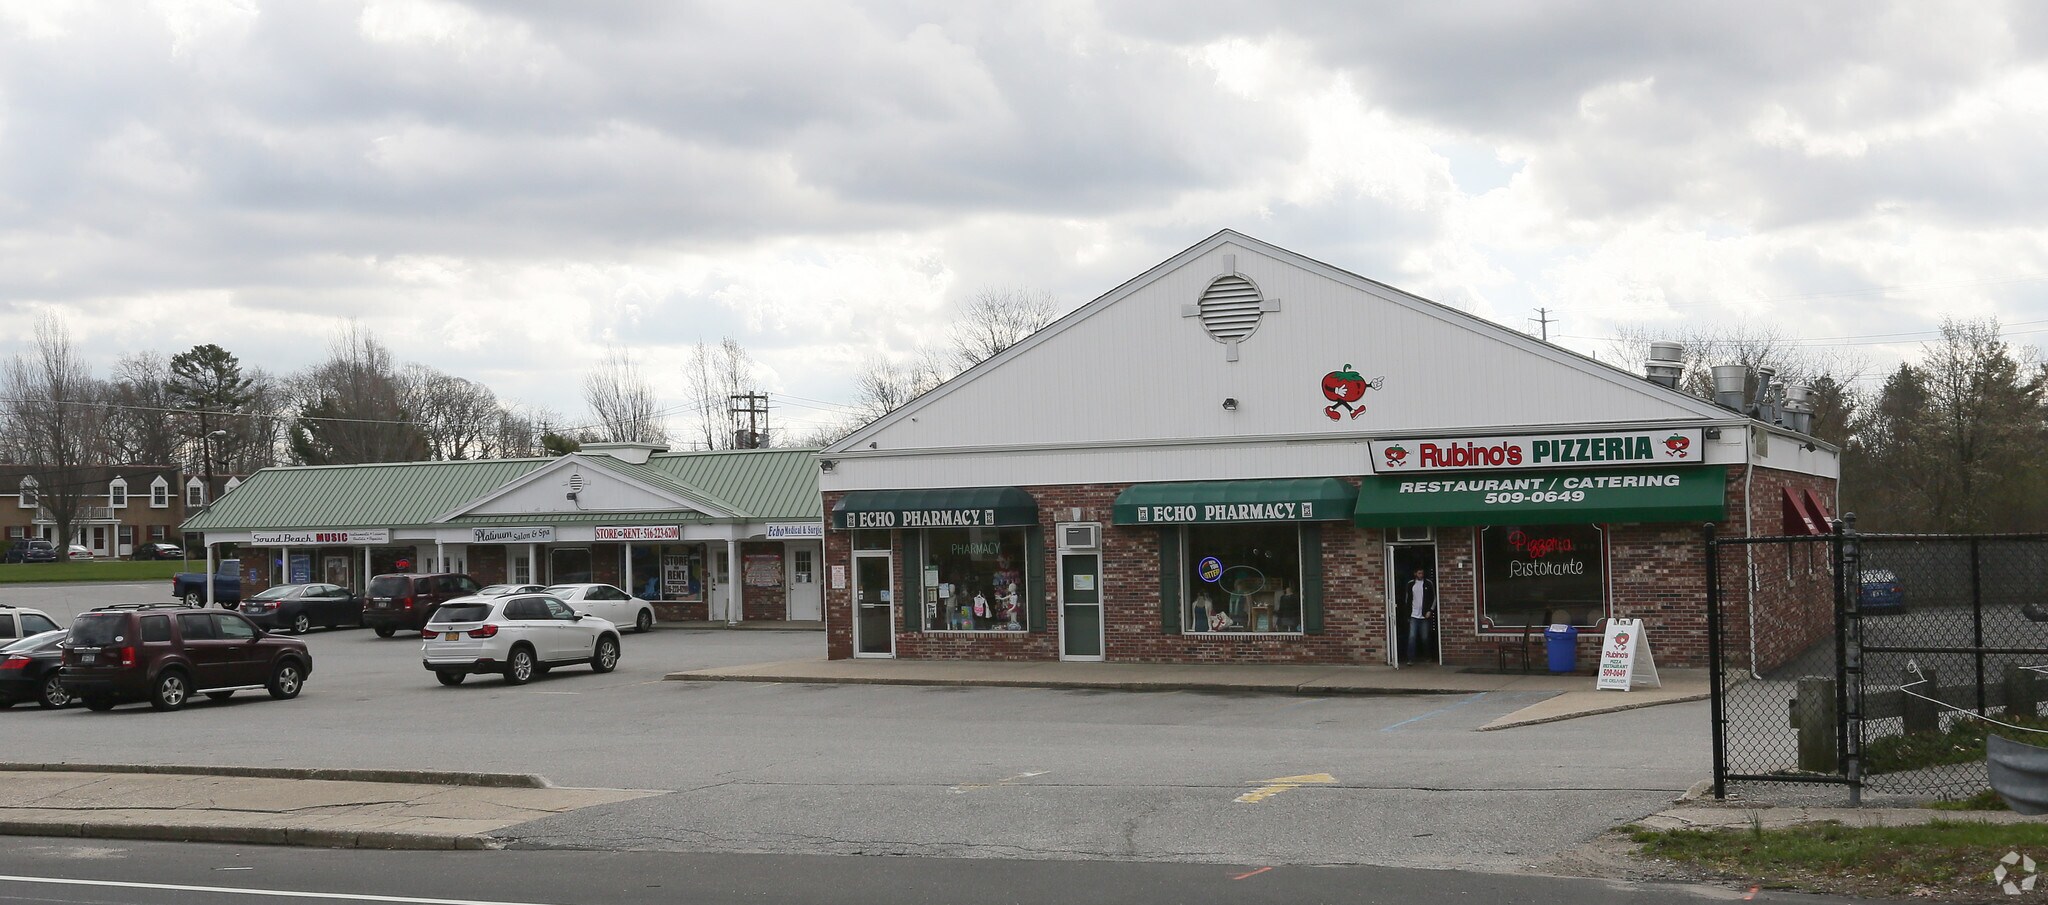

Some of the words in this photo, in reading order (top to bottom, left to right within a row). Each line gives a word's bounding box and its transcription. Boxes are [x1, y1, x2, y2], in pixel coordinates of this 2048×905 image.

[1420, 441, 1522, 468] Rubino's
[1532, 436, 1654, 463] PIZZERIA
[1399, 478, 1545, 493] RESTAURANT
[1563, 474, 1680, 489] CATERING
[1484, 491, 1585, 504] 509-0649
[859, 511, 896, 527] ECHO
[902, 509, 981, 526] PHARMACY
[1153, 505, 1197, 522] ECHO
[1205, 502, 1296, 521] PHARMACY
[253, 534, 283, 543] Sound
[283, 533, 313, 543] Beach
[316, 532, 348, 542] MUSIC
[475, 528, 512, 542] Platinum
[513, 532, 531, 541] Salon
[531, 530, 539, 538] &
[539, 528, 550, 538] Spa
[596, 528, 617, 539] STORE
[623, 527, 640, 539] RENT
[768, 525, 785, 537] Echo
[951, 543, 1000, 555] PHARMACY
[1508, 530, 1573, 558] Pizzeria
[664, 556, 689, 566] STORE
[1509, 557, 1583, 578] Ristorante
[667, 570, 686, 580] RENT
[1603, 669, 1626, 677] 509-0649
